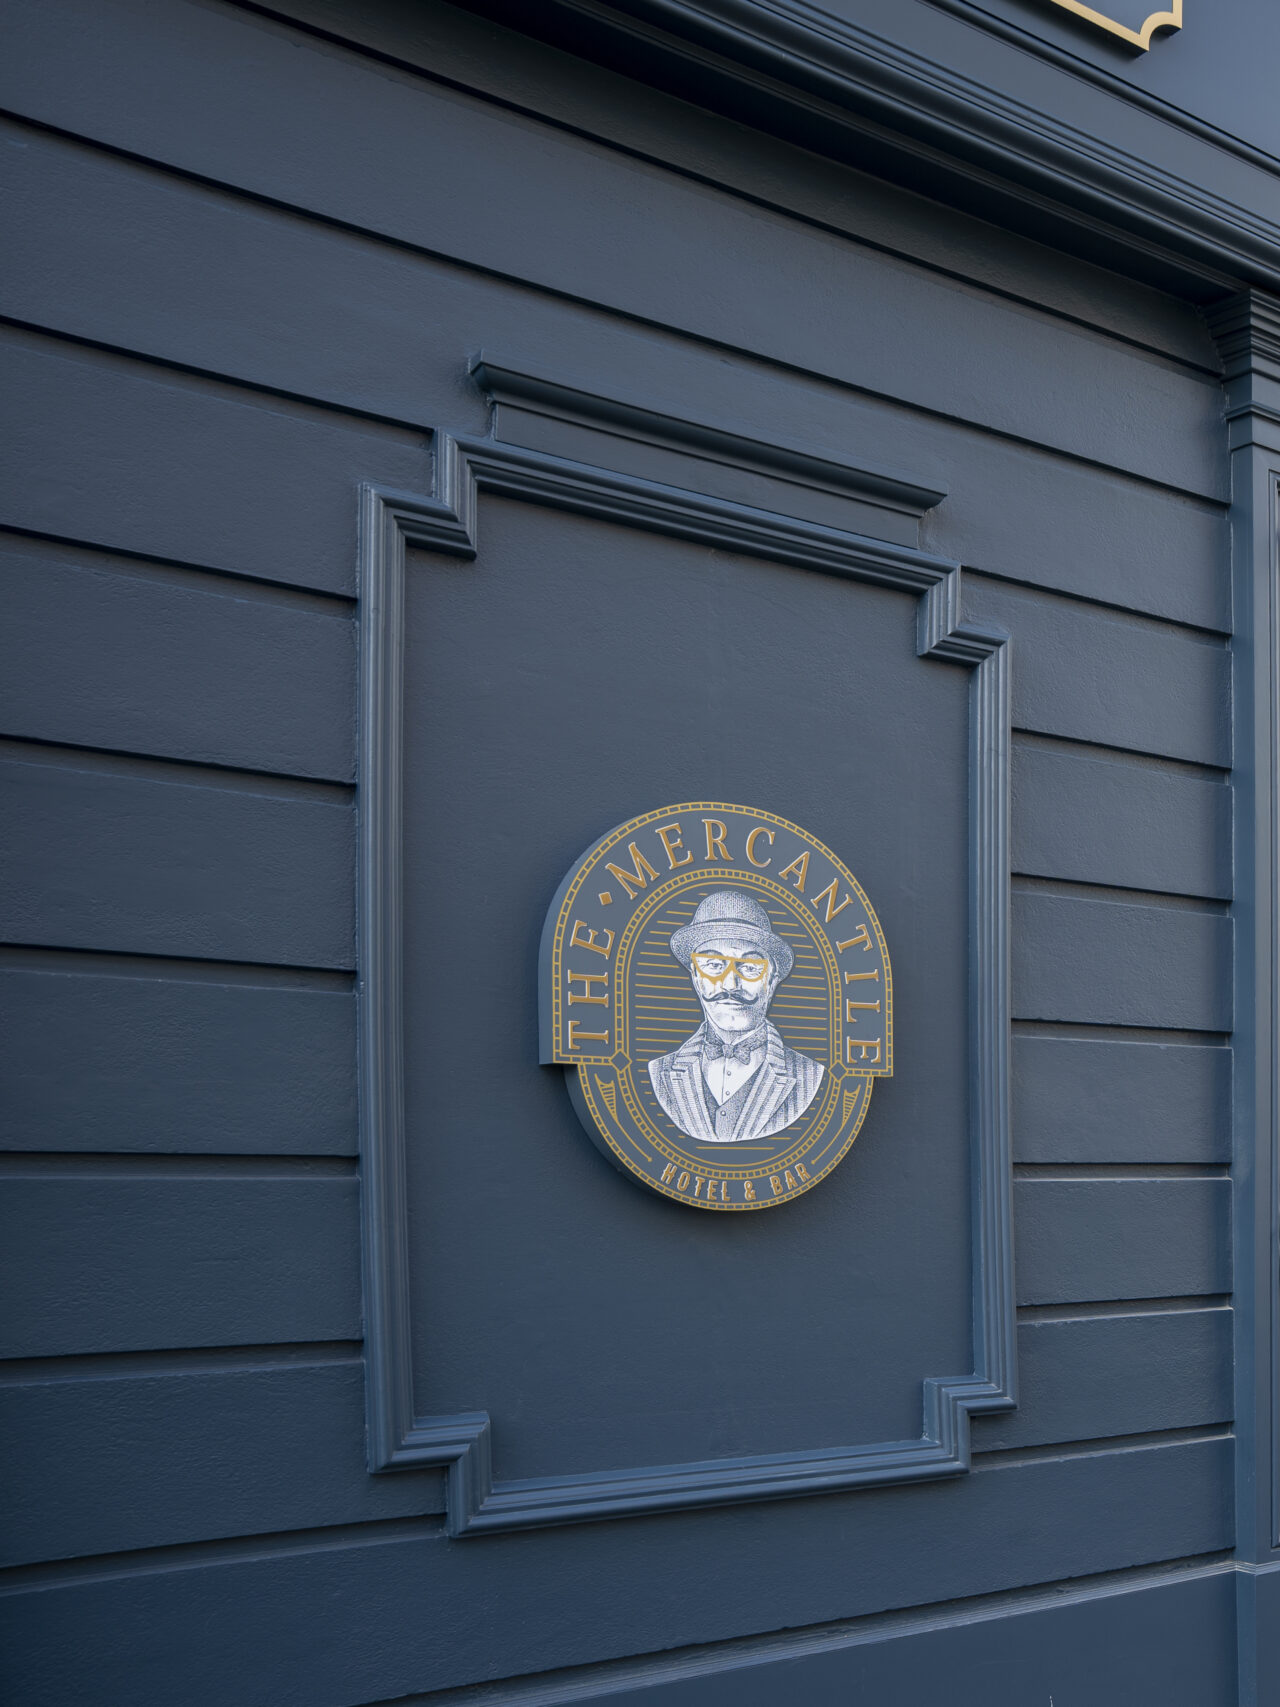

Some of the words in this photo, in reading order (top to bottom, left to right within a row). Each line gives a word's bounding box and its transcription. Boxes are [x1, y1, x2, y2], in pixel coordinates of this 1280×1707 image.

[567, 919, 616, 1051] THE
[604, 818, 883, 1065] MERCANTILE
[660, 1162, 732, 1202] HOTEL
[743, 1180, 756, 1201] &
[772, 1162, 812, 1197] BAR
